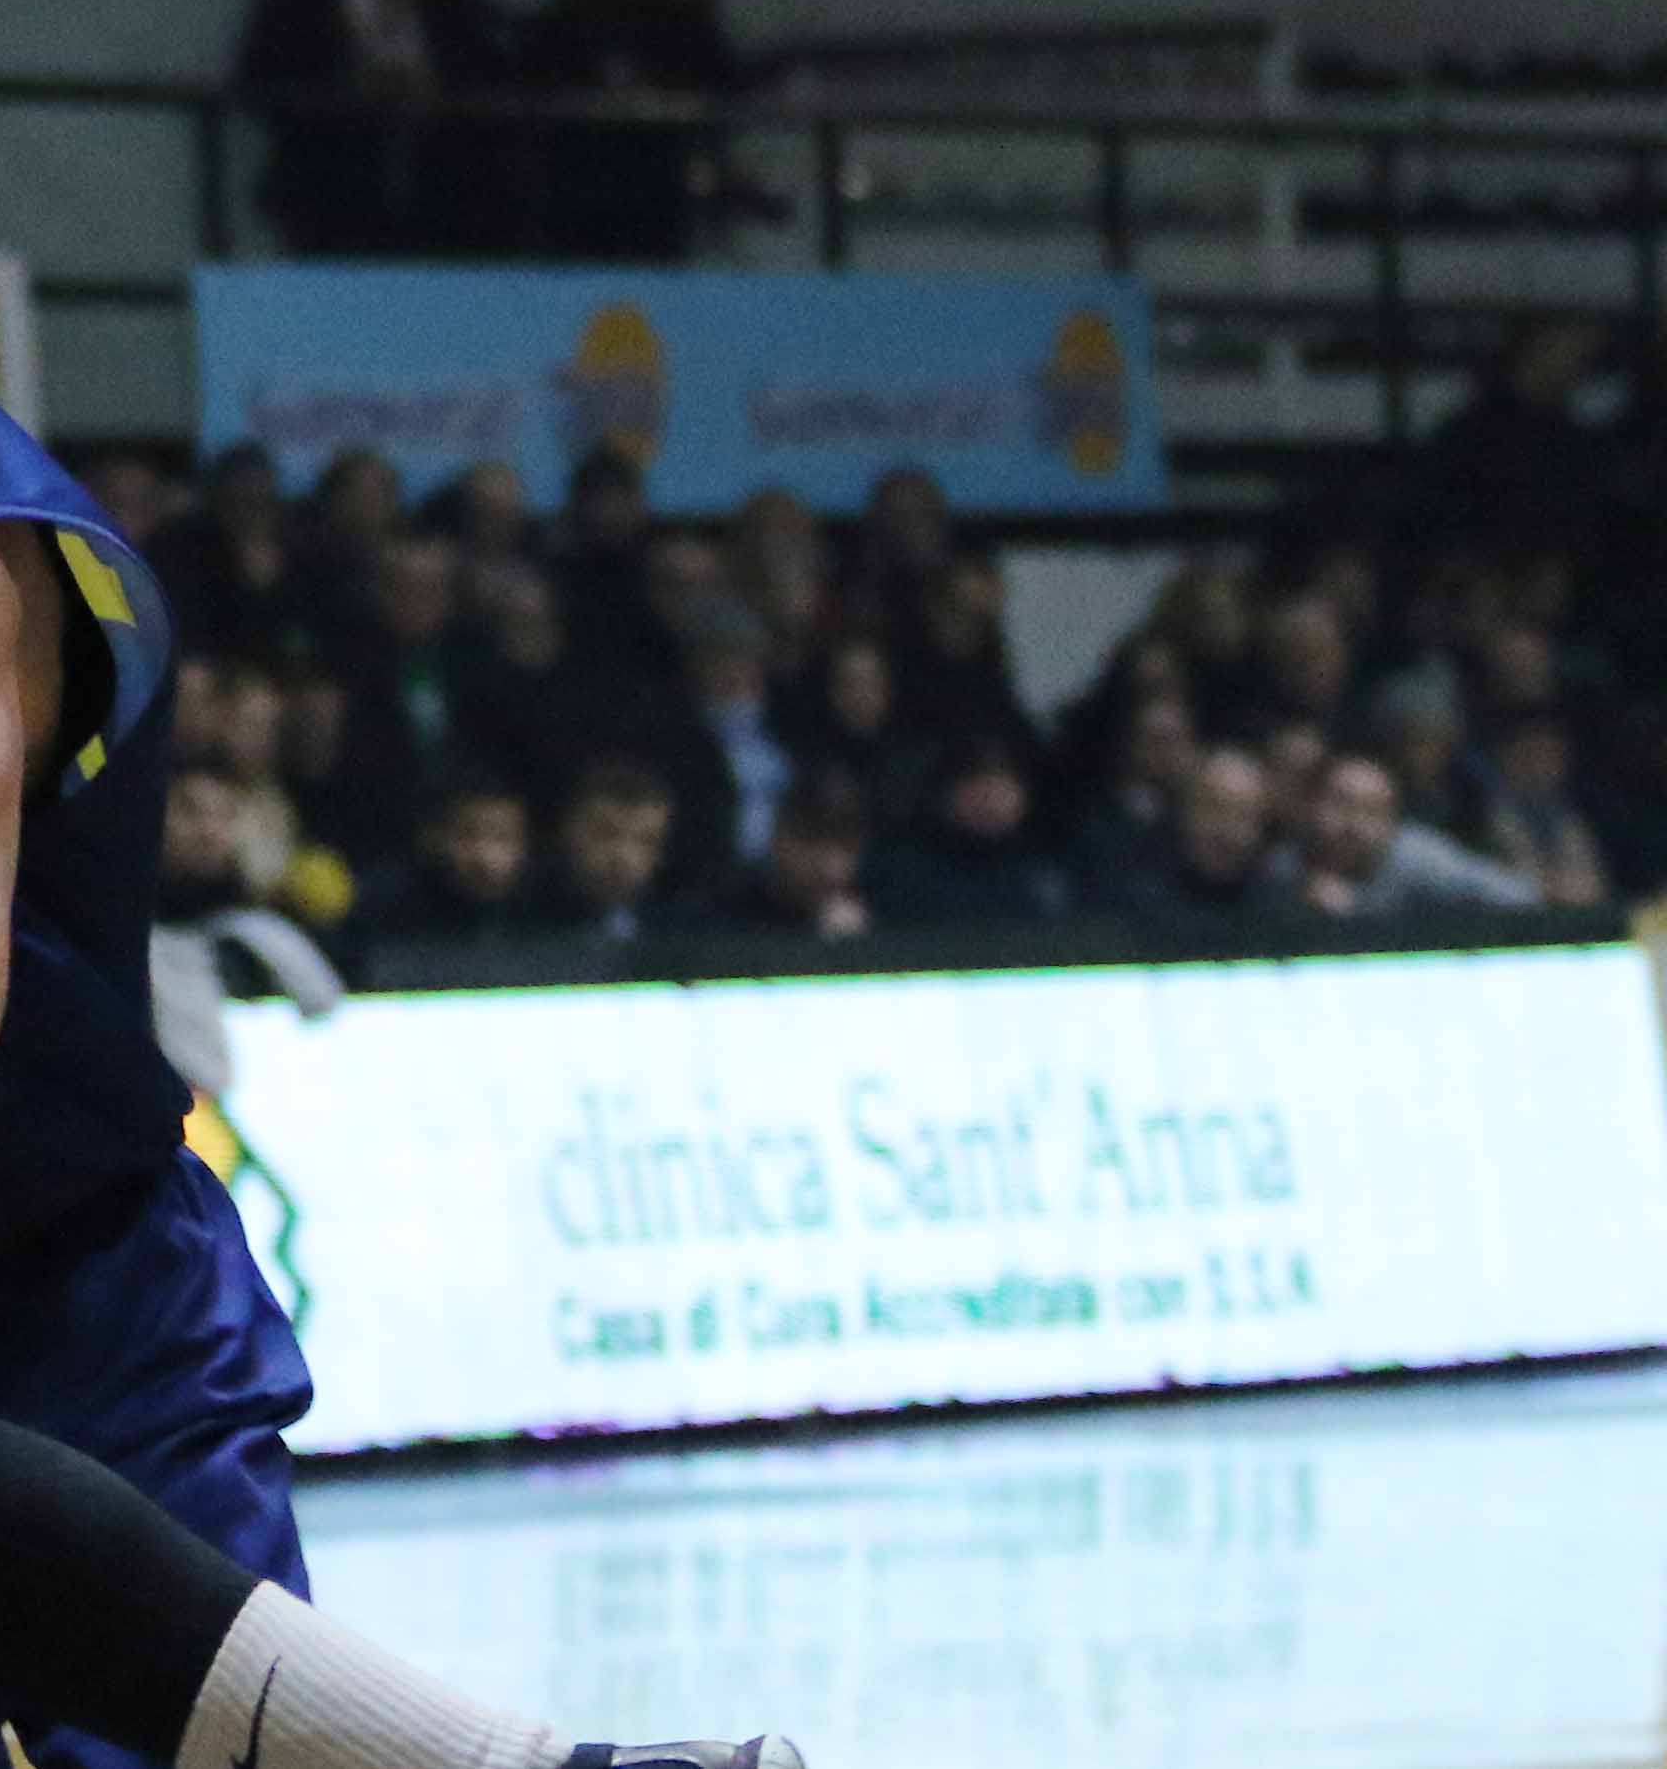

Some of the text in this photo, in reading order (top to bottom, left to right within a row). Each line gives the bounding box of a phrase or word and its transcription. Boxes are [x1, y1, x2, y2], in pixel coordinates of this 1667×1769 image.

[541, 1079, 835, 1250] clinica
[1076, 1074, 1301, 1216] Anna
[739, 1276, 844, 1347] Cura
